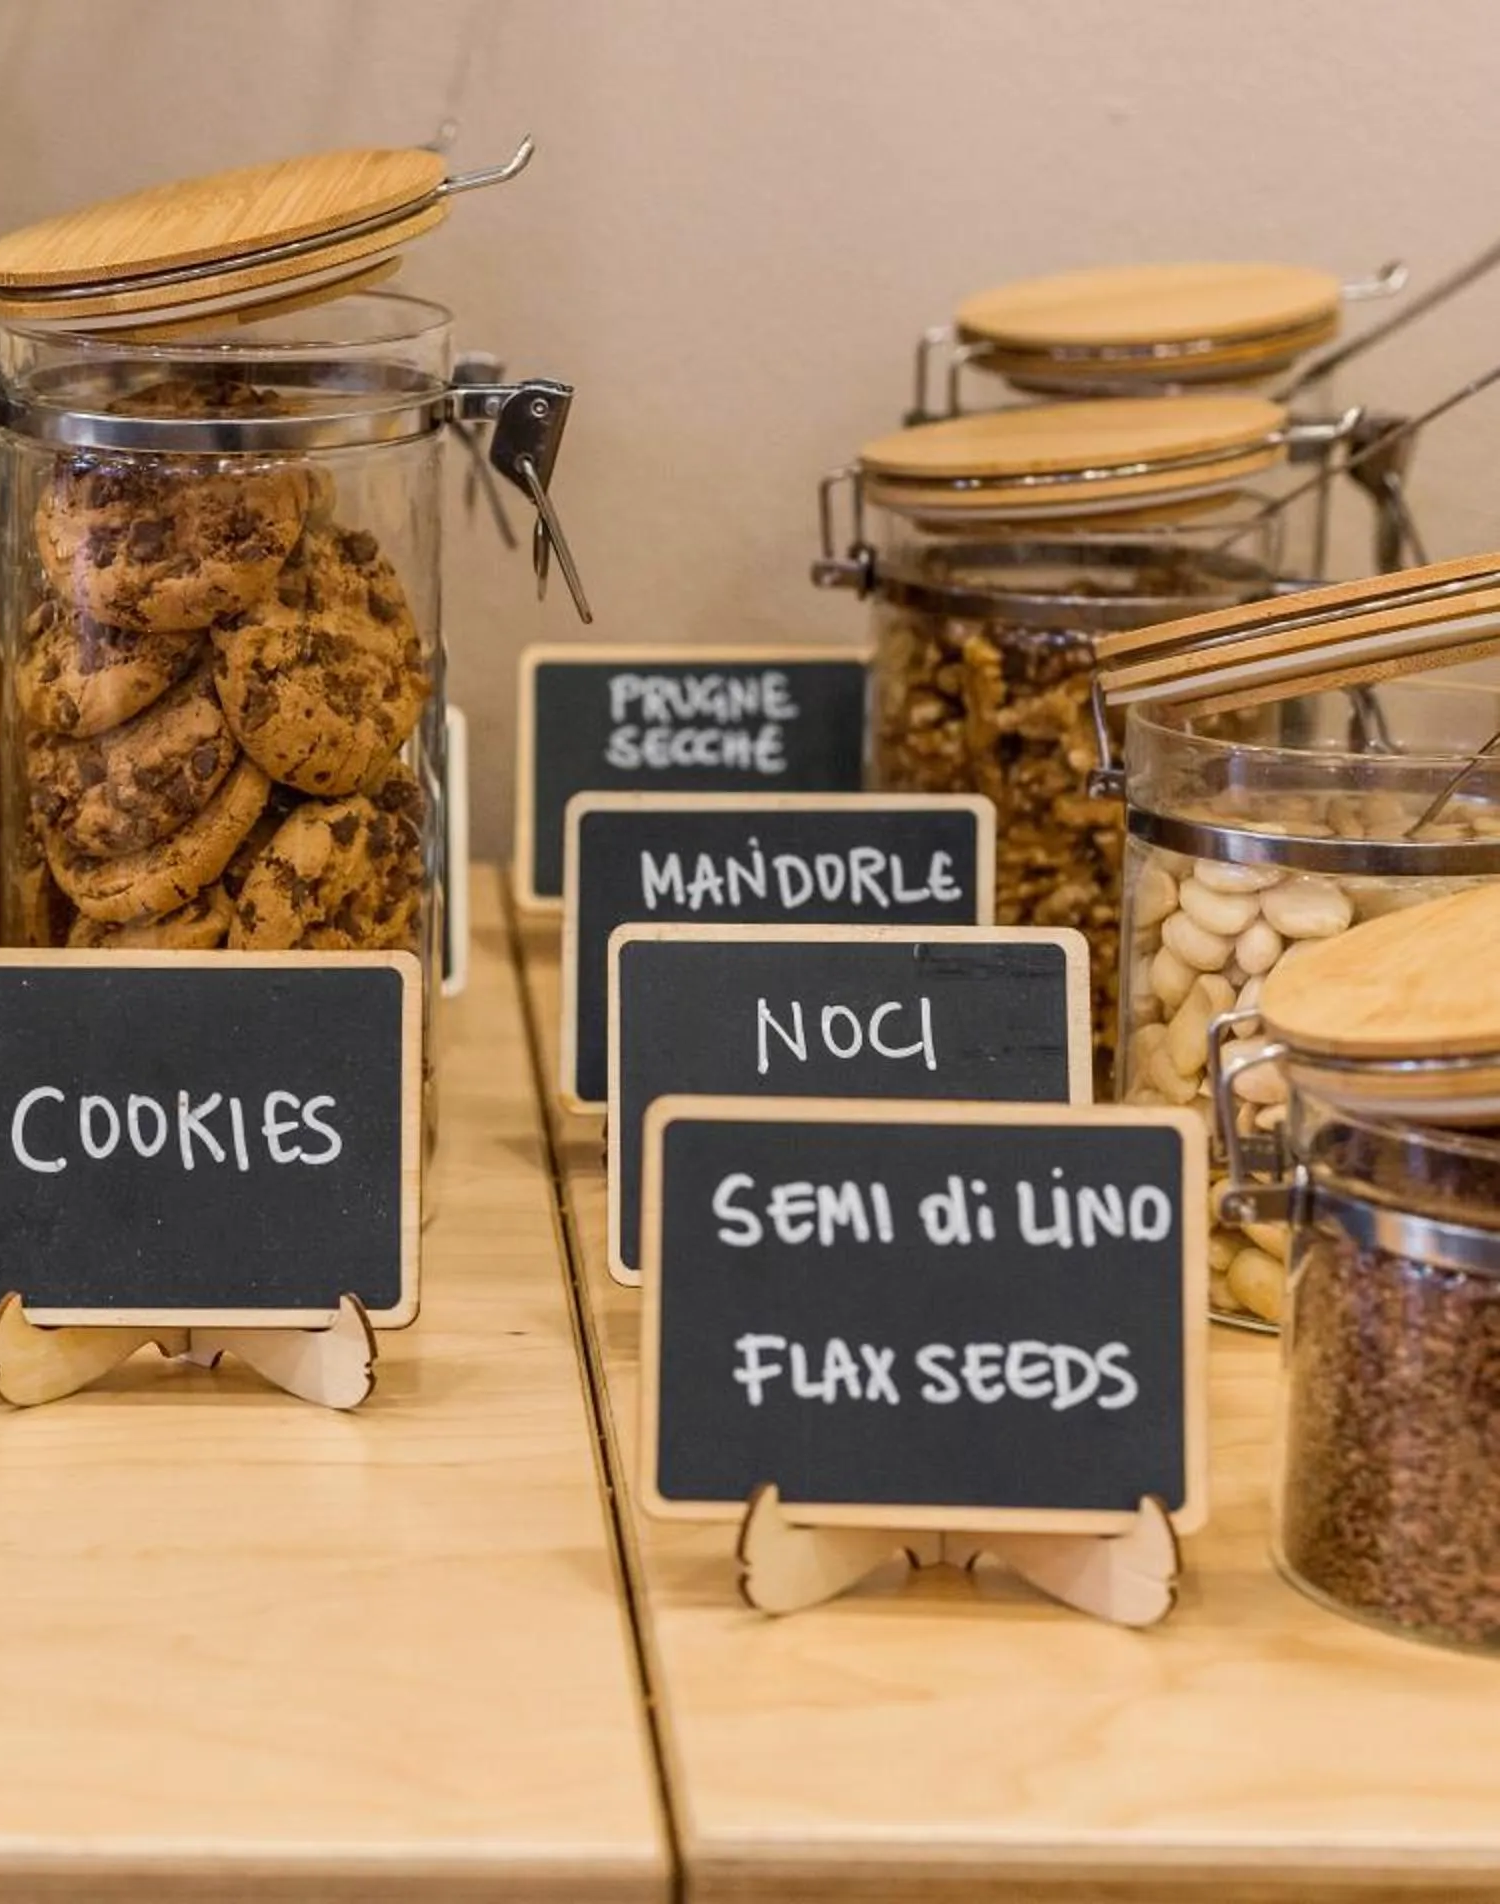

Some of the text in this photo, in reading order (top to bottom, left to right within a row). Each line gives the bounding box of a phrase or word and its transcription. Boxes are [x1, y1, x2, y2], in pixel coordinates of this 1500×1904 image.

[607, 673, 797, 722] PRUGNE
[605, 725, 786, 773] SECCHE
[641, 837, 962, 911] MANDORLE
[757, 996, 937, 1075] NOCI
[11, 1085, 343, 1173] COOKIES
[712, 1173, 894, 1247] SEMI
[918, 1175, 996, 1246] di
[733, 1333, 1138, 1411] FLAX SEEDS
